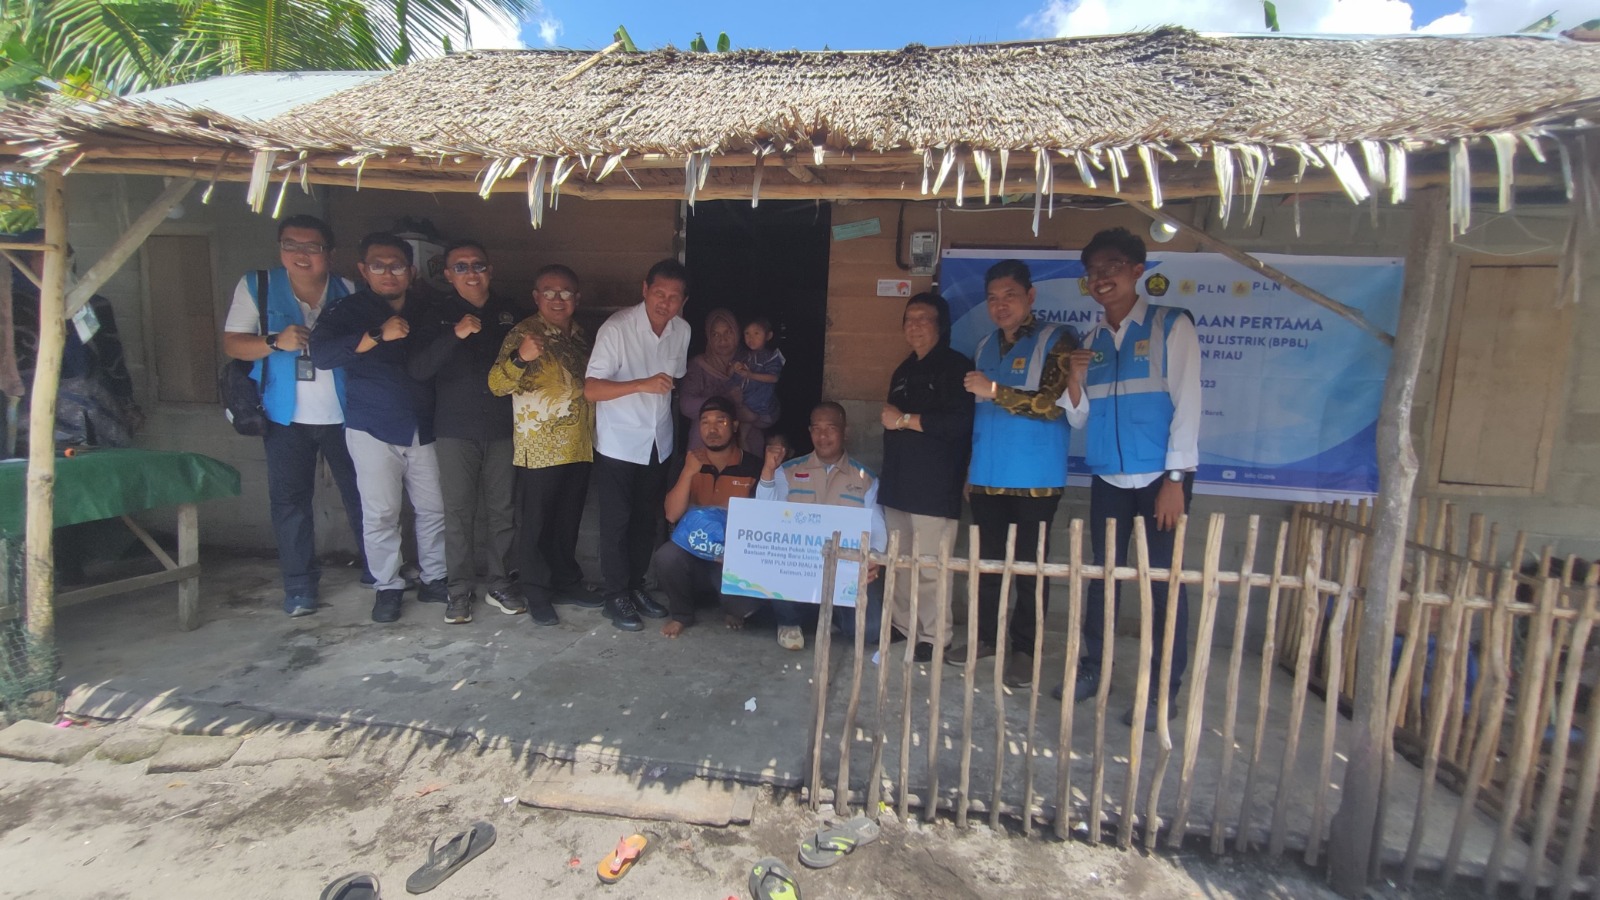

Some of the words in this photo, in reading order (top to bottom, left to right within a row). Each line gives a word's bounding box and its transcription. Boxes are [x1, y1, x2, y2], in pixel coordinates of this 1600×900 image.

[1197, 284, 1226, 294] PLN
[1252, 281, 1281, 291] PLN
[1239, 316, 1323, 331] PERTAMA
[1217, 335, 1266, 346] LISTRIK
[1268, 337, 1309, 349] (BPBL)
[1213, 350, 1243, 360] RIAU
[737, 528, 802, 545] PROGRAM
[804, 534, 860, 550] NAAH
